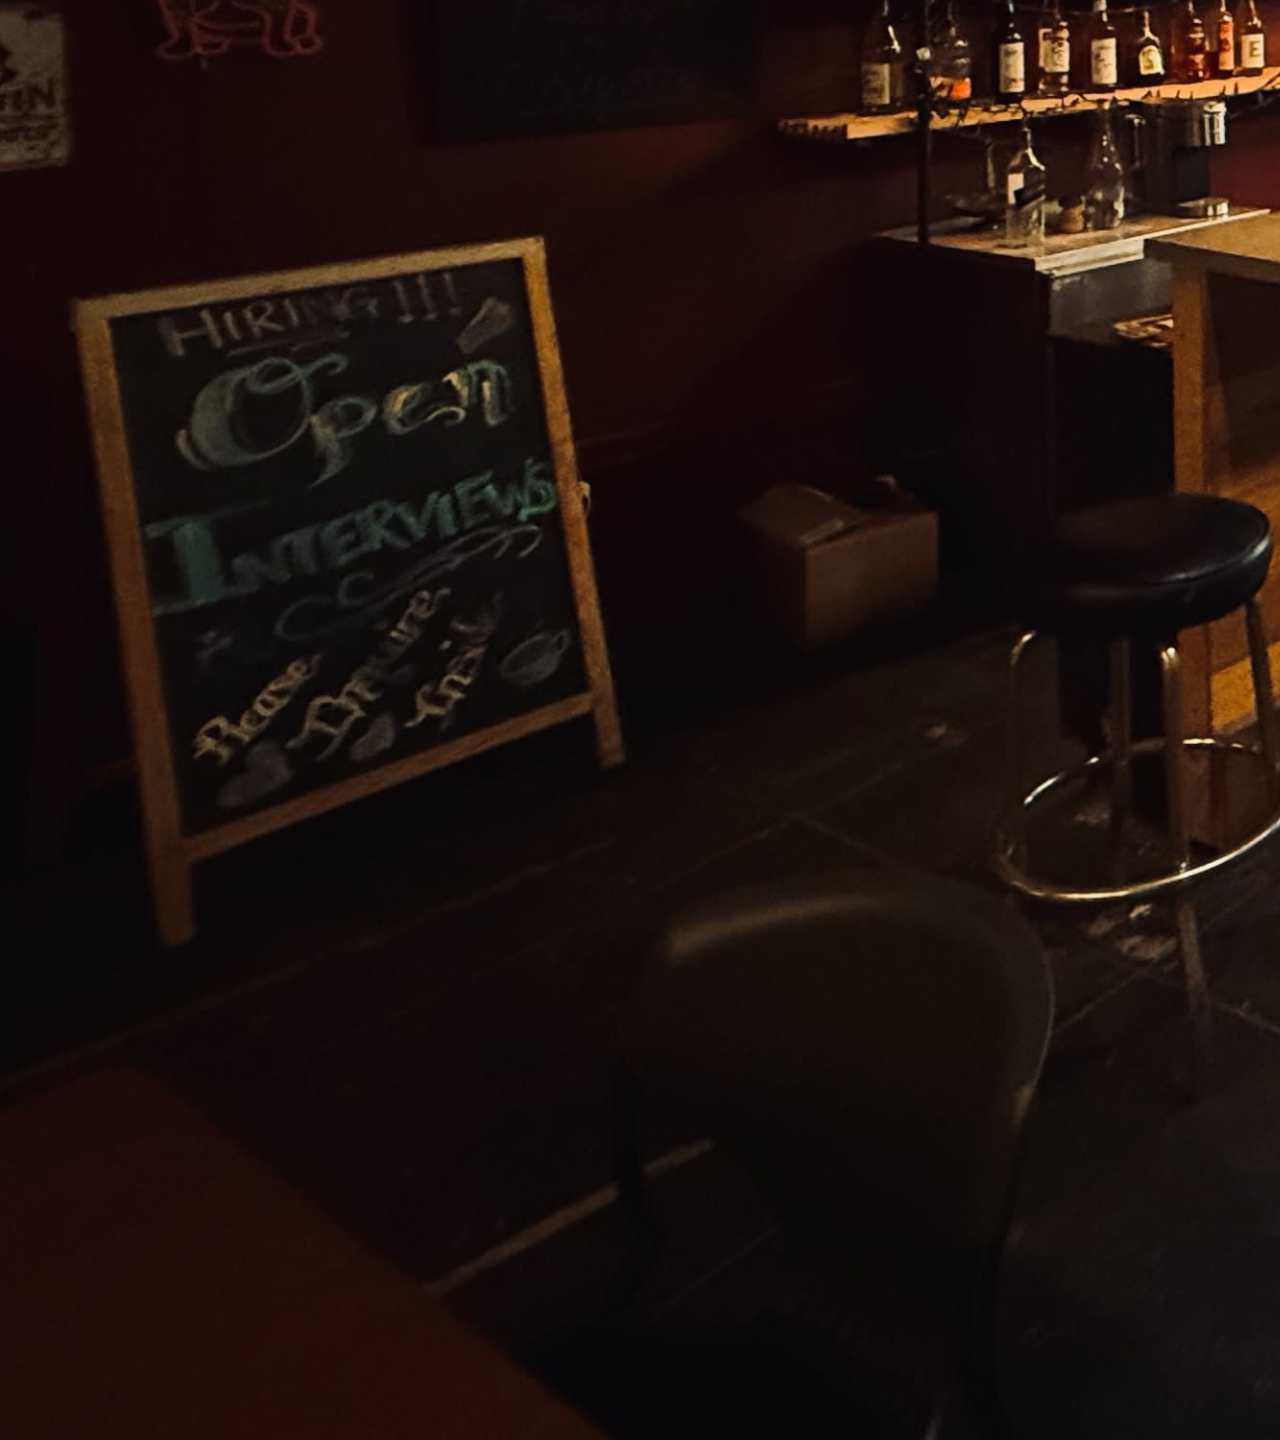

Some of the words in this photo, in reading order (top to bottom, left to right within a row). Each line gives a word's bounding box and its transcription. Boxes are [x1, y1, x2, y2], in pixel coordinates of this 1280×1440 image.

[175, 352, 514, 488] Open
[145, 457, 557, 617] INTERVIEWS
[191, 654, 323, 766] Please
